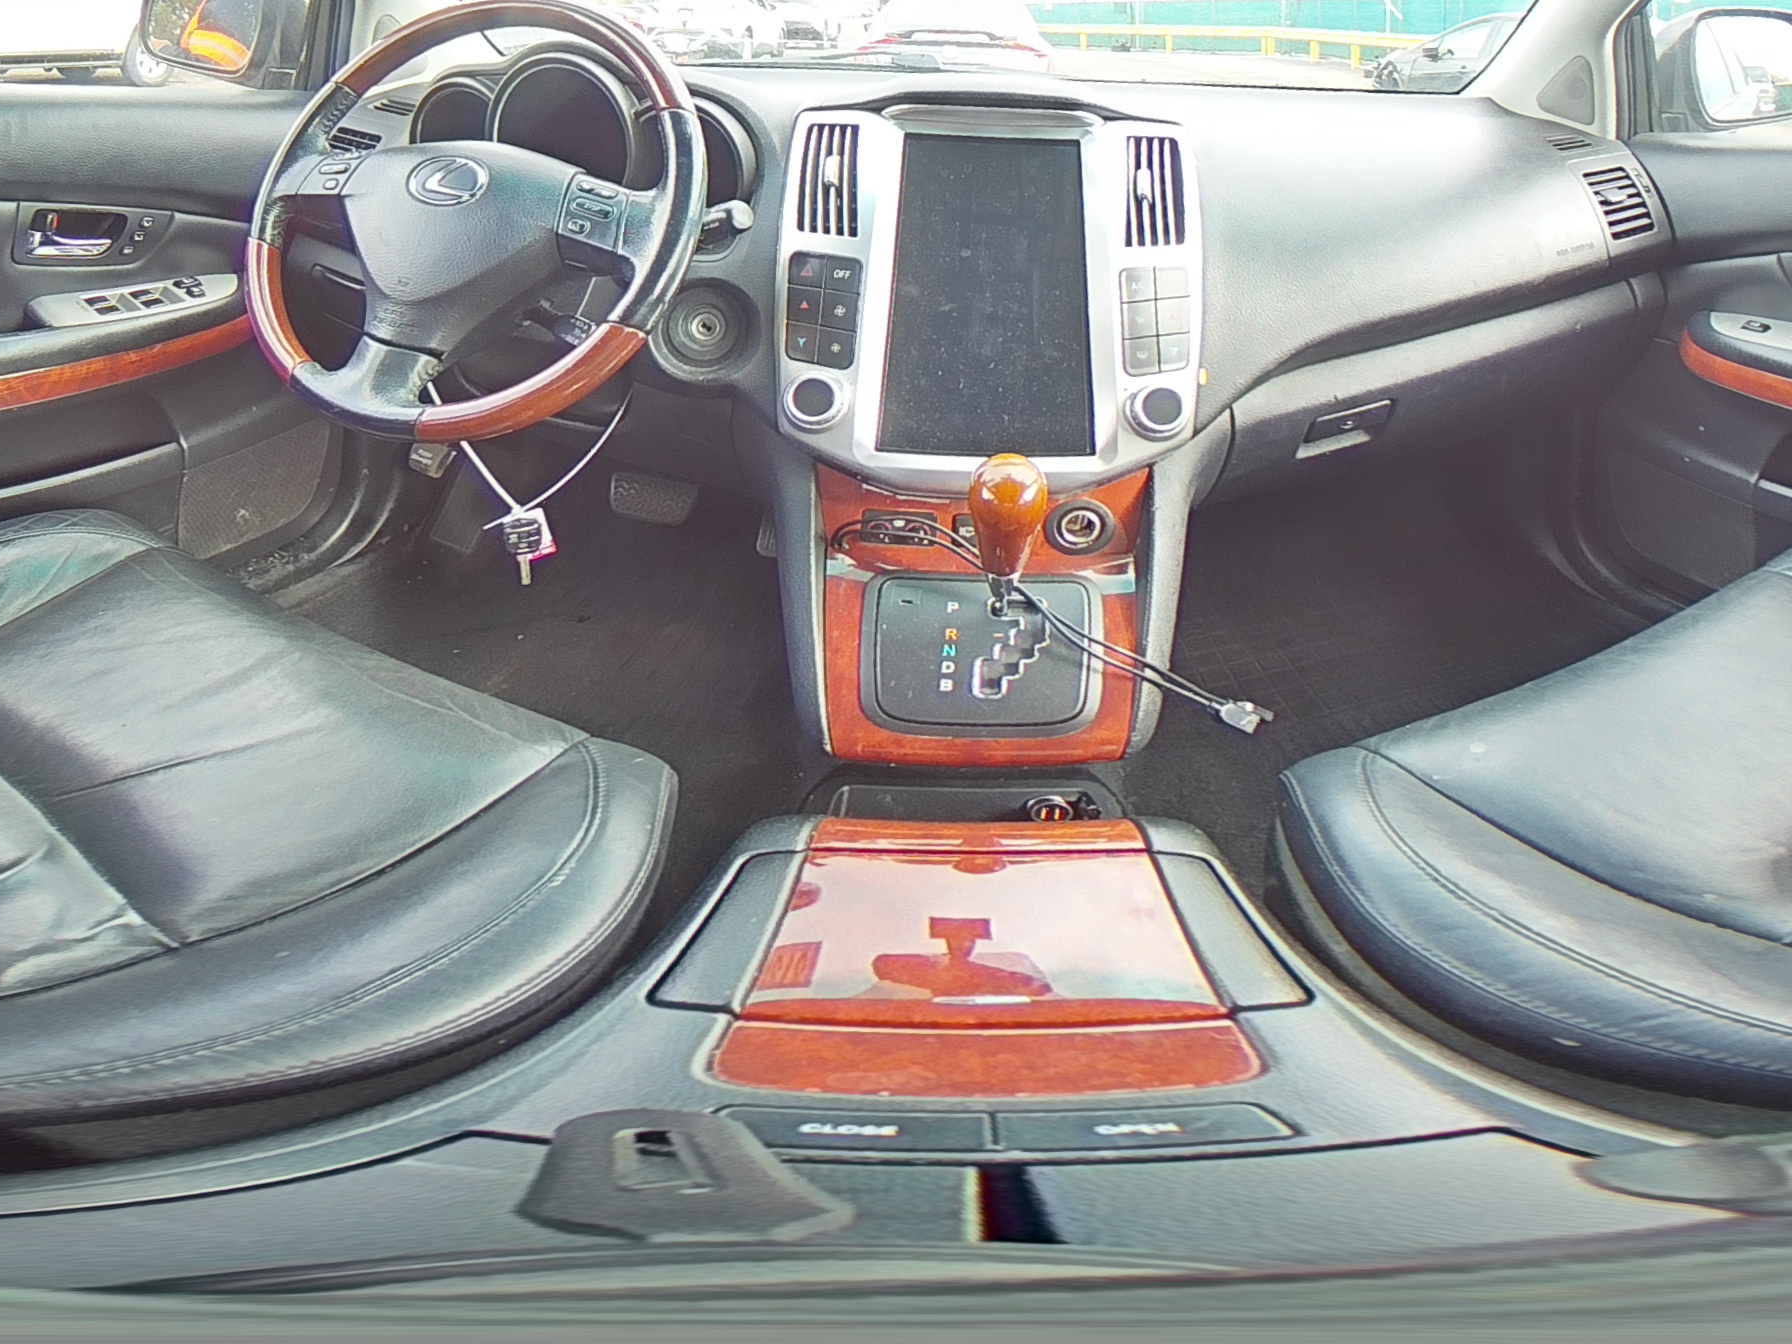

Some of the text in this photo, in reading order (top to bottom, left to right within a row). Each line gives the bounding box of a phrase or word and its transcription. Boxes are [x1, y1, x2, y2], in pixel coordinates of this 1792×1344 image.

[833, 268, 852, 280] OFF
[946, 601, 960, 614] P
[944, 628, 958, 641] R
[942, 644, 956, 657] N
[940, 660, 956, 674] D
[938, 678, 954, 692] B
[798, 1122, 900, 1136] CLOSE
[1092, 1122, 1184, 1136] OPEN
